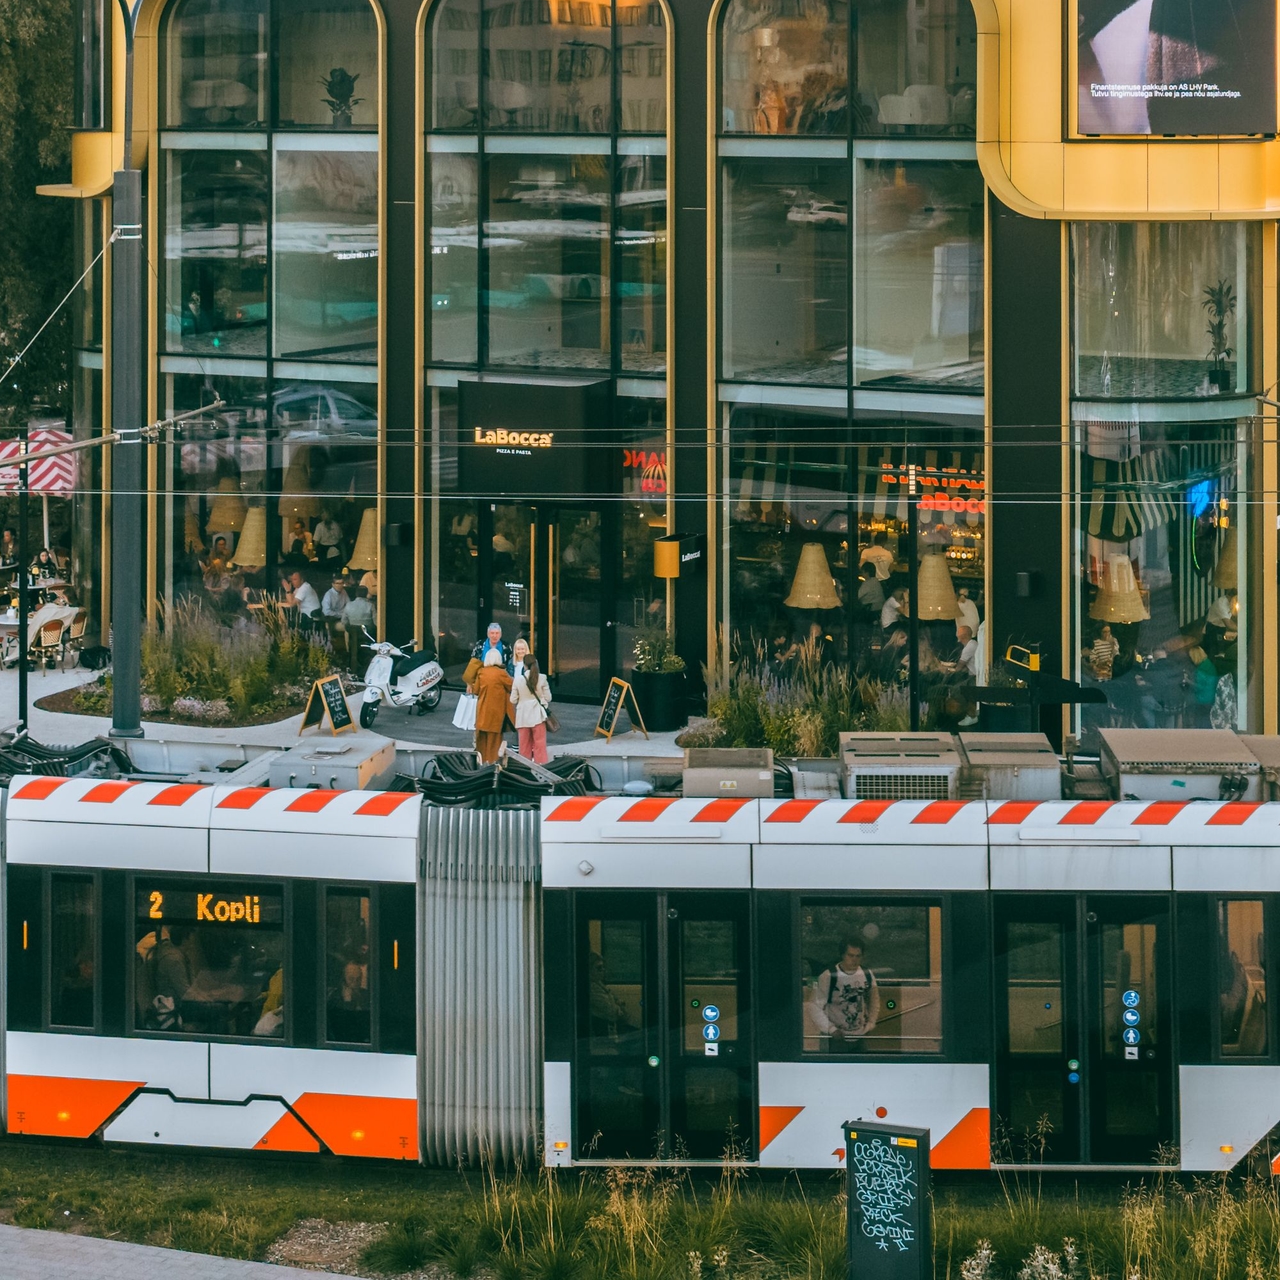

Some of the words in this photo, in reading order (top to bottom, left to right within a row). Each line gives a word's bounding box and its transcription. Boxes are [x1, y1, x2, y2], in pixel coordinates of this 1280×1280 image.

[1178, 83, 1188, 91] AS
[1189, 83, 1202, 91] LHV
[475, 427, 554, 448] LaBocca
[149, 890, 163, 919] 2
[197, 893, 260, 923] Kopli
